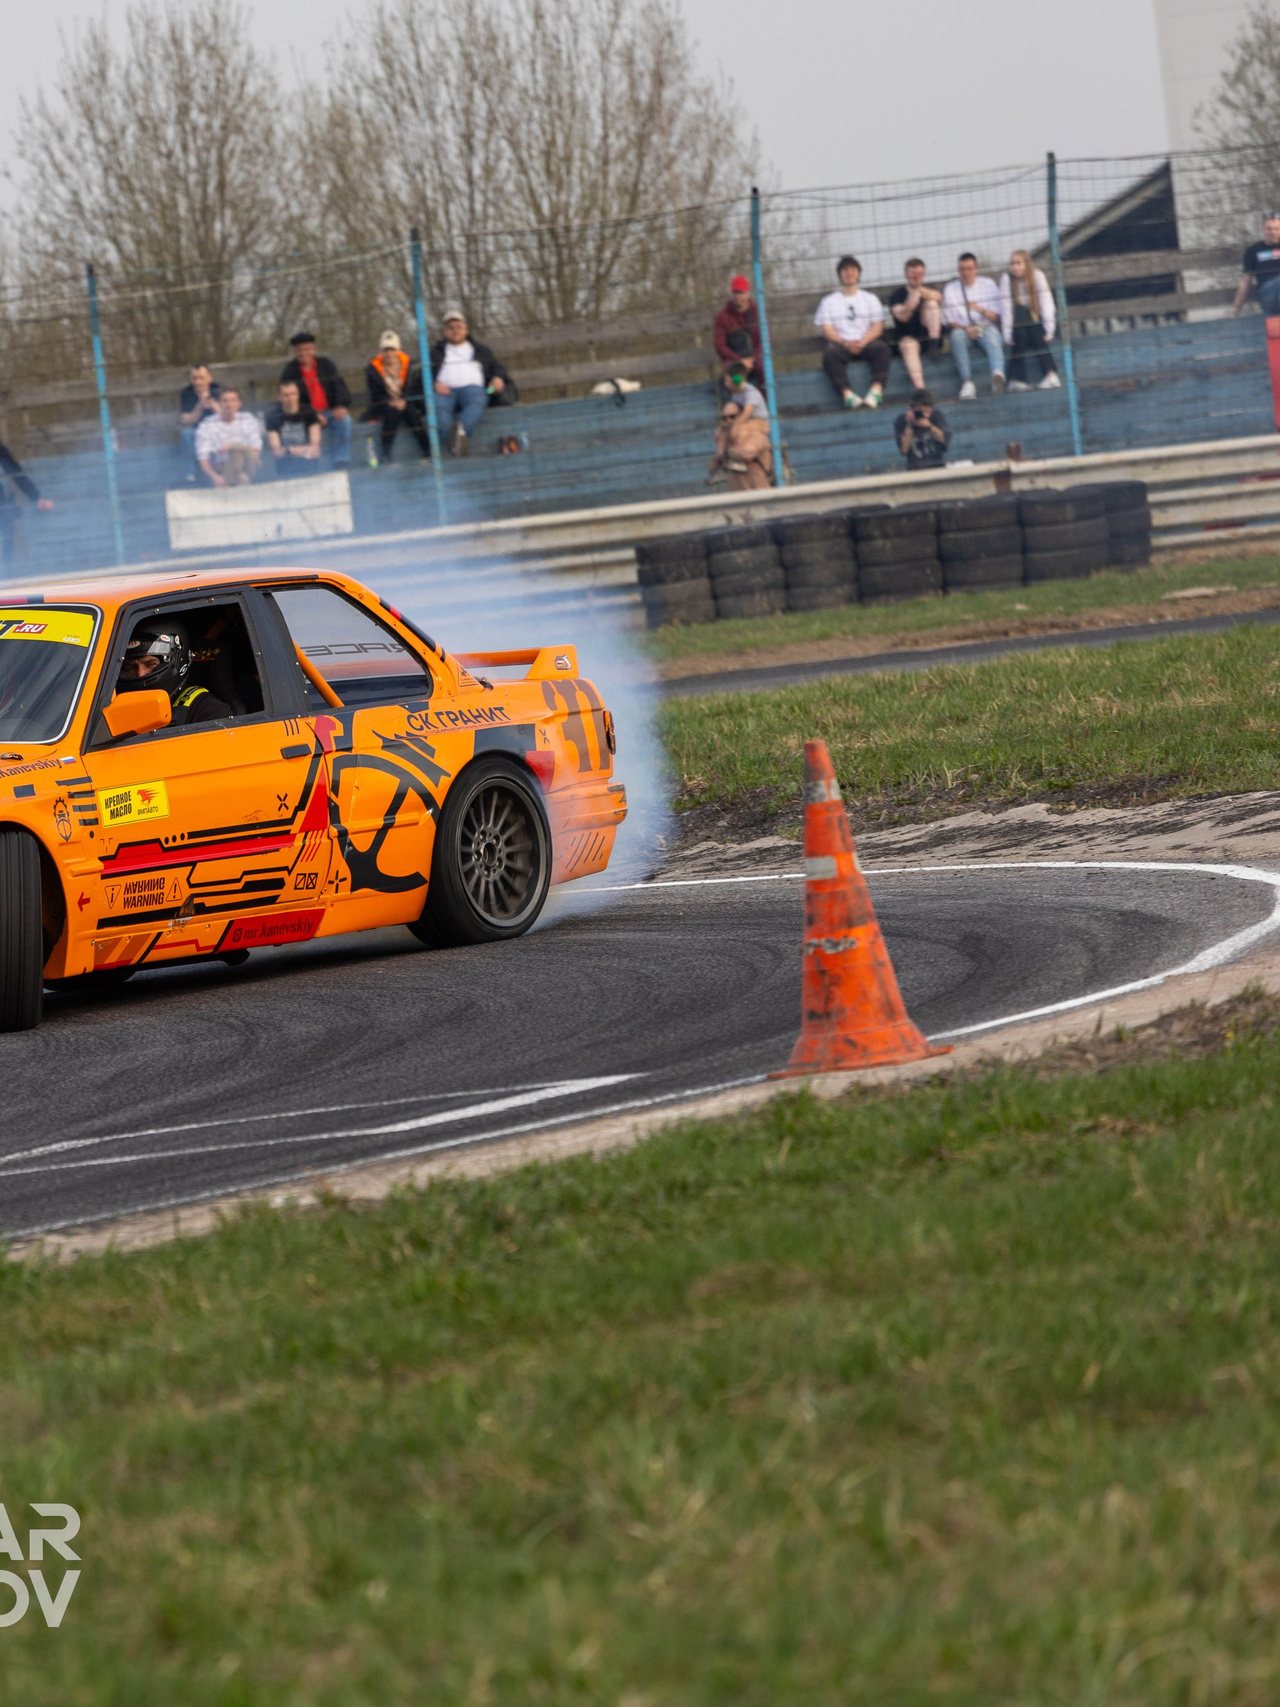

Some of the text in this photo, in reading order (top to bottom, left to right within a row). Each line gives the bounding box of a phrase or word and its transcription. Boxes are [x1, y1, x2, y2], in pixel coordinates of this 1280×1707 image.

[406, 712, 439, 731] СК
[434, 706, 511, 728] ГРАНИТ
[104, 790, 132, 810] КРЕПКОЕ
[110, 803, 132, 820] МАСЛО
[123, 892, 165, 909] WARNING
[243, 918, 314, 940] mr.kanevskiy
